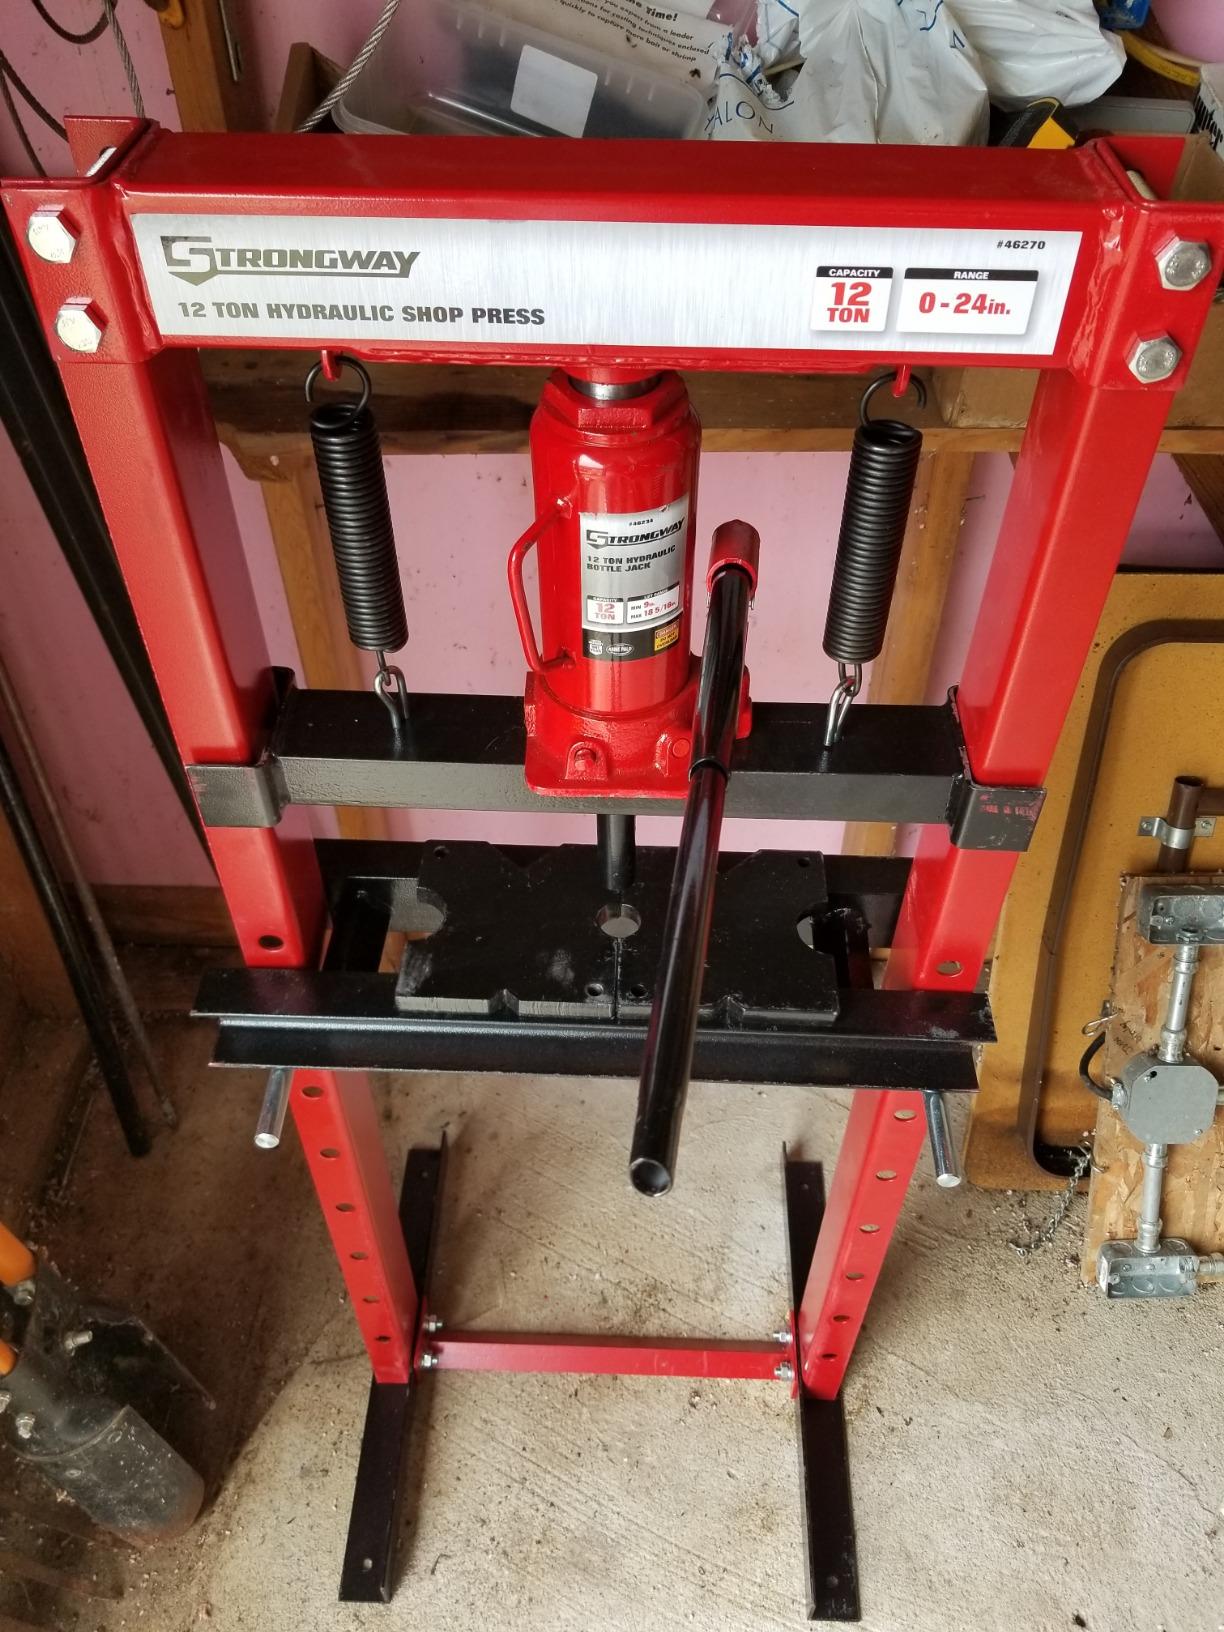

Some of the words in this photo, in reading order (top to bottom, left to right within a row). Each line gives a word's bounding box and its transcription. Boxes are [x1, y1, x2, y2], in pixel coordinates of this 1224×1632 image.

[646, 6, 678, 21] Time!
[670, 30, 694, 40] leader
[678, 43, 710, 54] enclosed
[671, 51, 697, 62] shrimp
[996, 240, 1046, 250] #46270
[160, 236, 420, 284] STRONGWAY
[828, 268, 881, 278] CAPACITY
[953, 271, 989, 280] RANGE
[831, 281, 873, 306] 12
[178, 302, 206, 318] 12
[212, 302, 259, 319] TON
[267, 303, 394, 321] HYDRAULIC
[401, 305, 464, 322] SHOP
[471, 307, 545, 325] PRESS
[826, 307, 870, 323] TON
[586, 517, 685, 549] STRONGWAY
[588, 555, 600, 563] 12
[603, 557, 623, 565] TON
[626, 545, 676, 564] HYDRAULIC
[586, 563, 622, 572] BOTTLE
[625, 562, 651, 572] JACK
[596, 602, 615, 614] 12
[595, 612, 616, 620] TON
